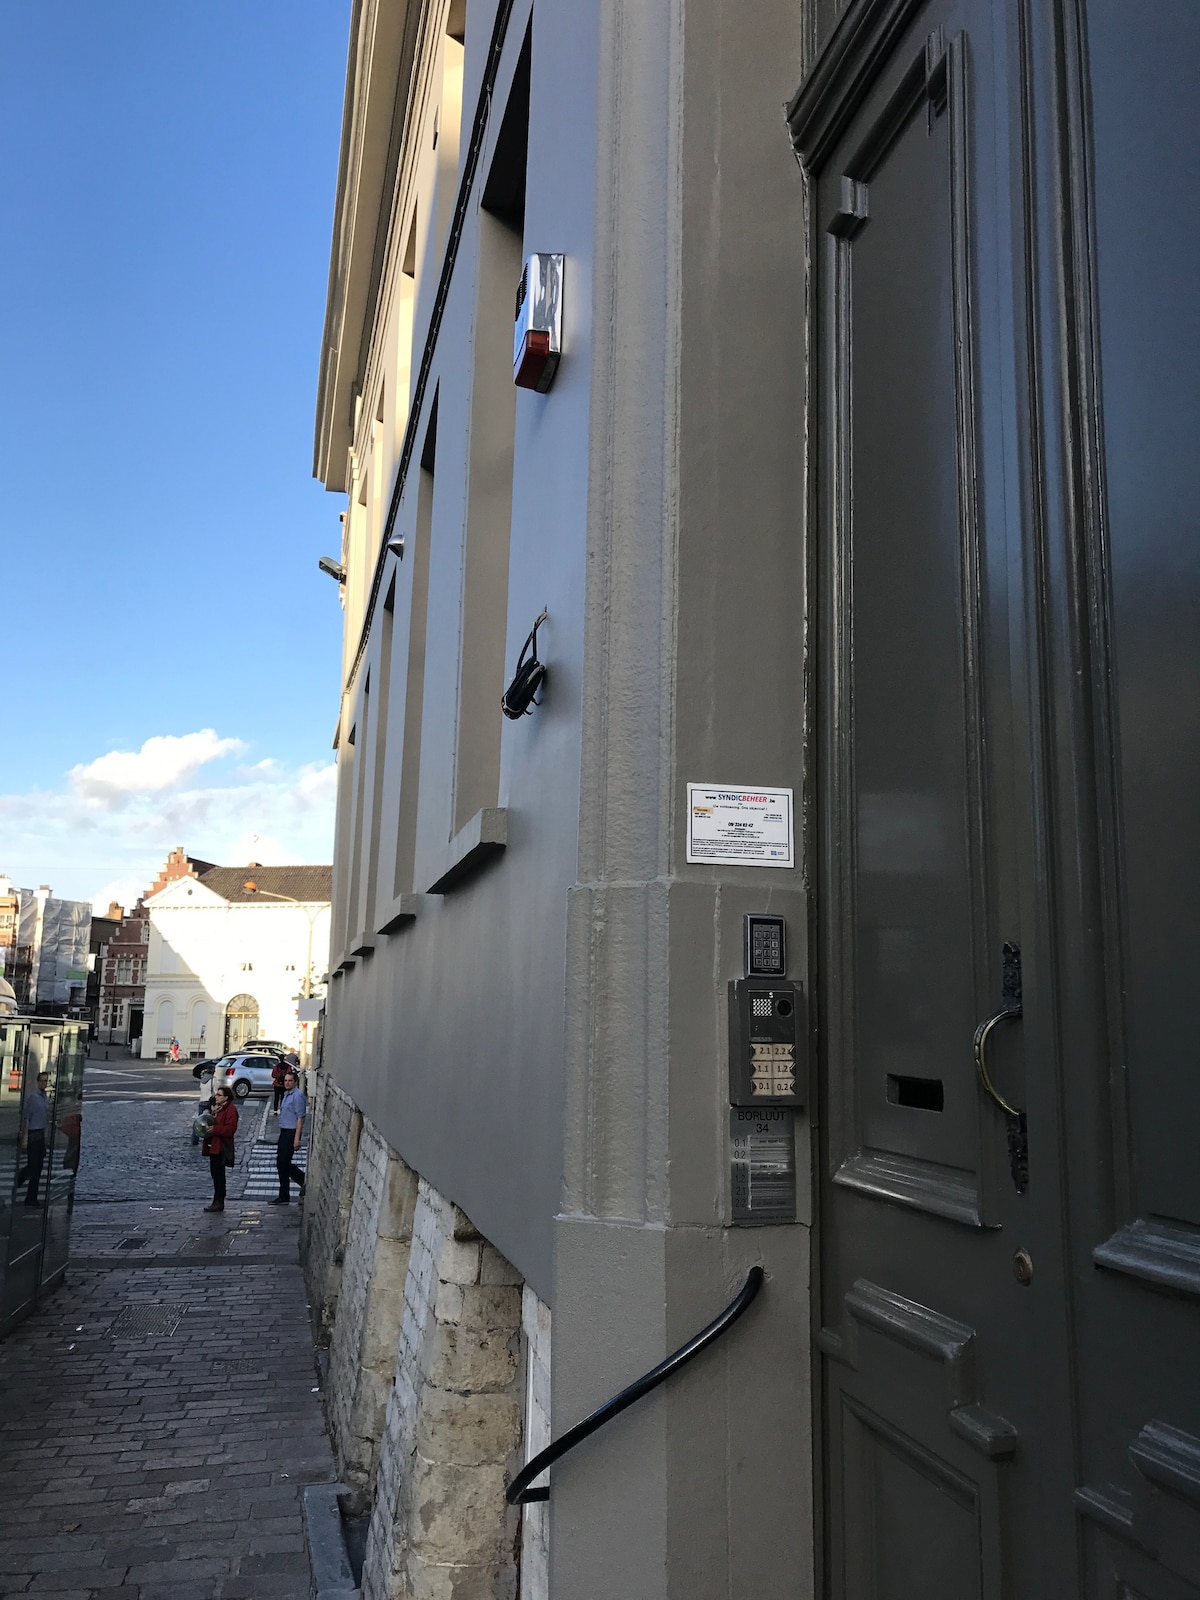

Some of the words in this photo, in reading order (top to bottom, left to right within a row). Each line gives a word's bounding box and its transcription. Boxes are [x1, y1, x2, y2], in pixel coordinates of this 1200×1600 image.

[718, 794, 768, 803] SYNDICBEHEER
[760, 1047, 771, 1055] 2.1
[775, 1047, 786, 1055] 2.2
[758, 1065, 769, 1073] 1.1
[777, 1065, 788, 1073] 1.2
[758, 1082, 770, 1090] 0.1
[776, 1083, 789, 1091] 0.2
[738, 1111, 786, 1121] BORLUUT
[756, 1123, 769, 1133] 34
